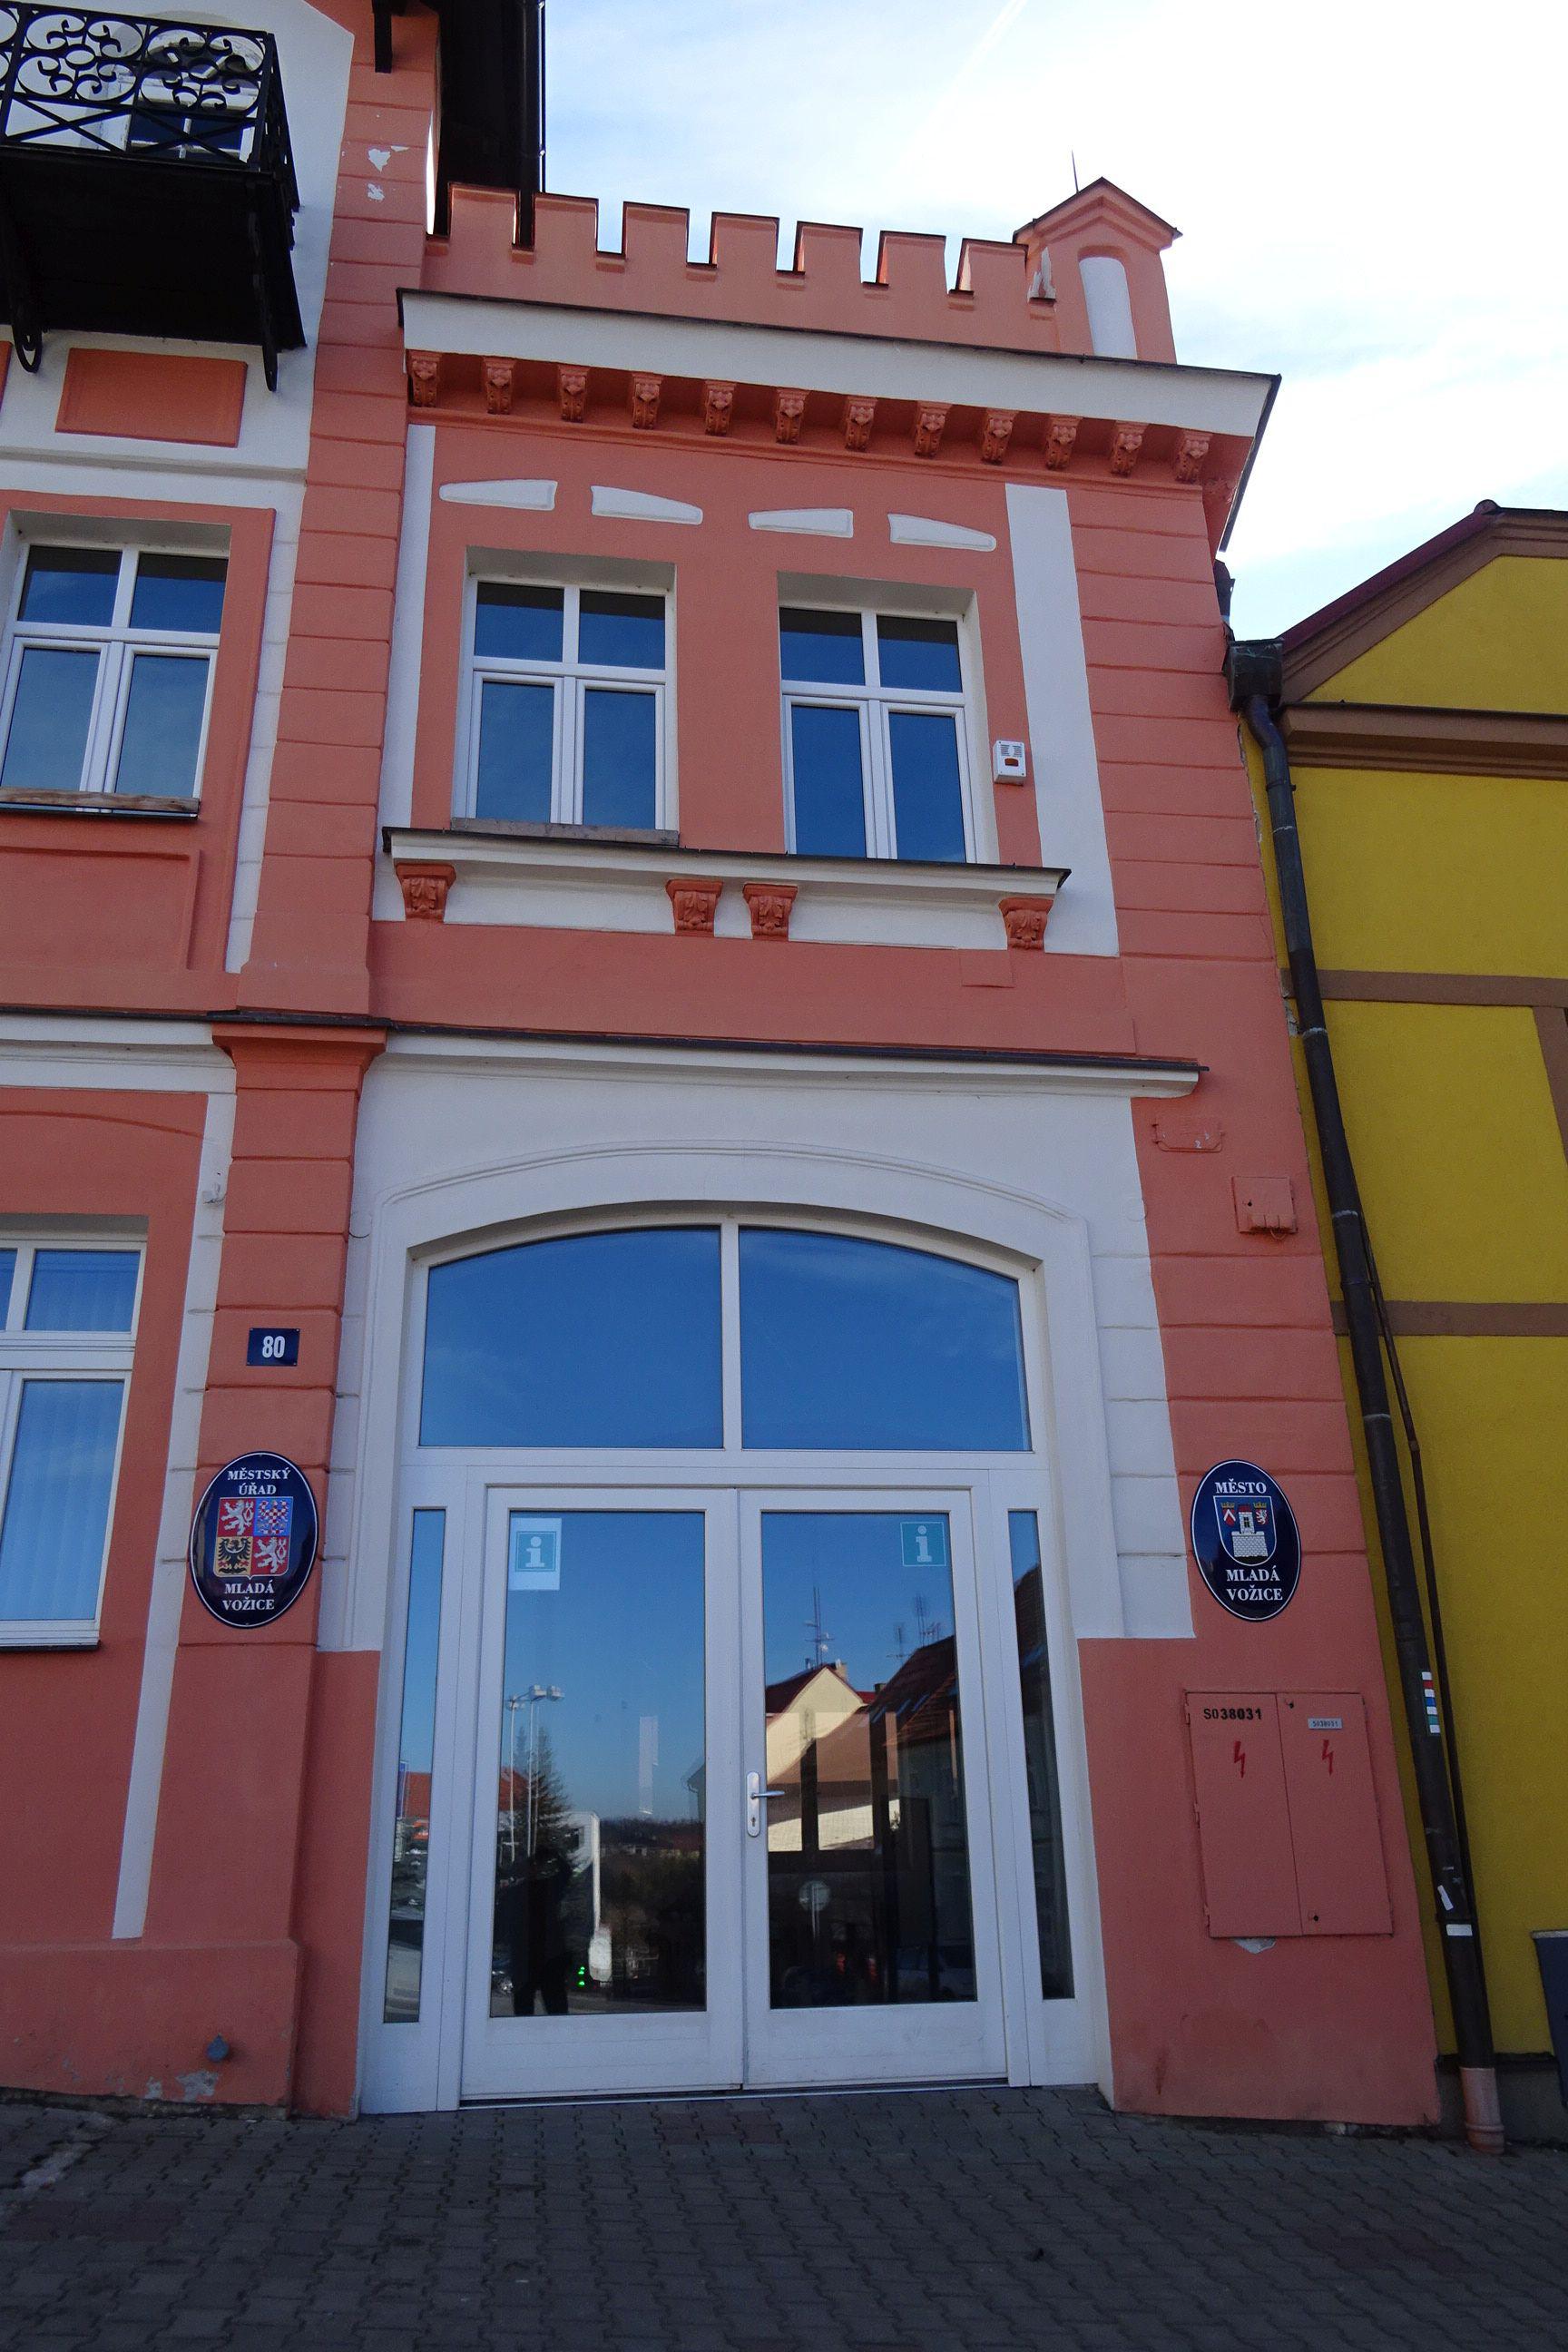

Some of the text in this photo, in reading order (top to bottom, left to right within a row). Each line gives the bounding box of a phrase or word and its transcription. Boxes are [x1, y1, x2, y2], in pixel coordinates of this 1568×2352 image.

[262, 1336, 285, 1358] 80
[228, 1467, 291, 1481] MĚSTSKÝ
[239, 1483, 277, 1495] ÚŘAD
[1215, 1478, 1267, 1494] MĚSTO
[1227, 1565, 1280, 1582] MLADÁ
[225, 1580, 274, 1594] MLADÁ
[1227, 1585, 1283, 1601] VOŽICE
[222, 1596, 275, 1611] VOŽICE
[1203, 1708, 1261, 1720] S038031
